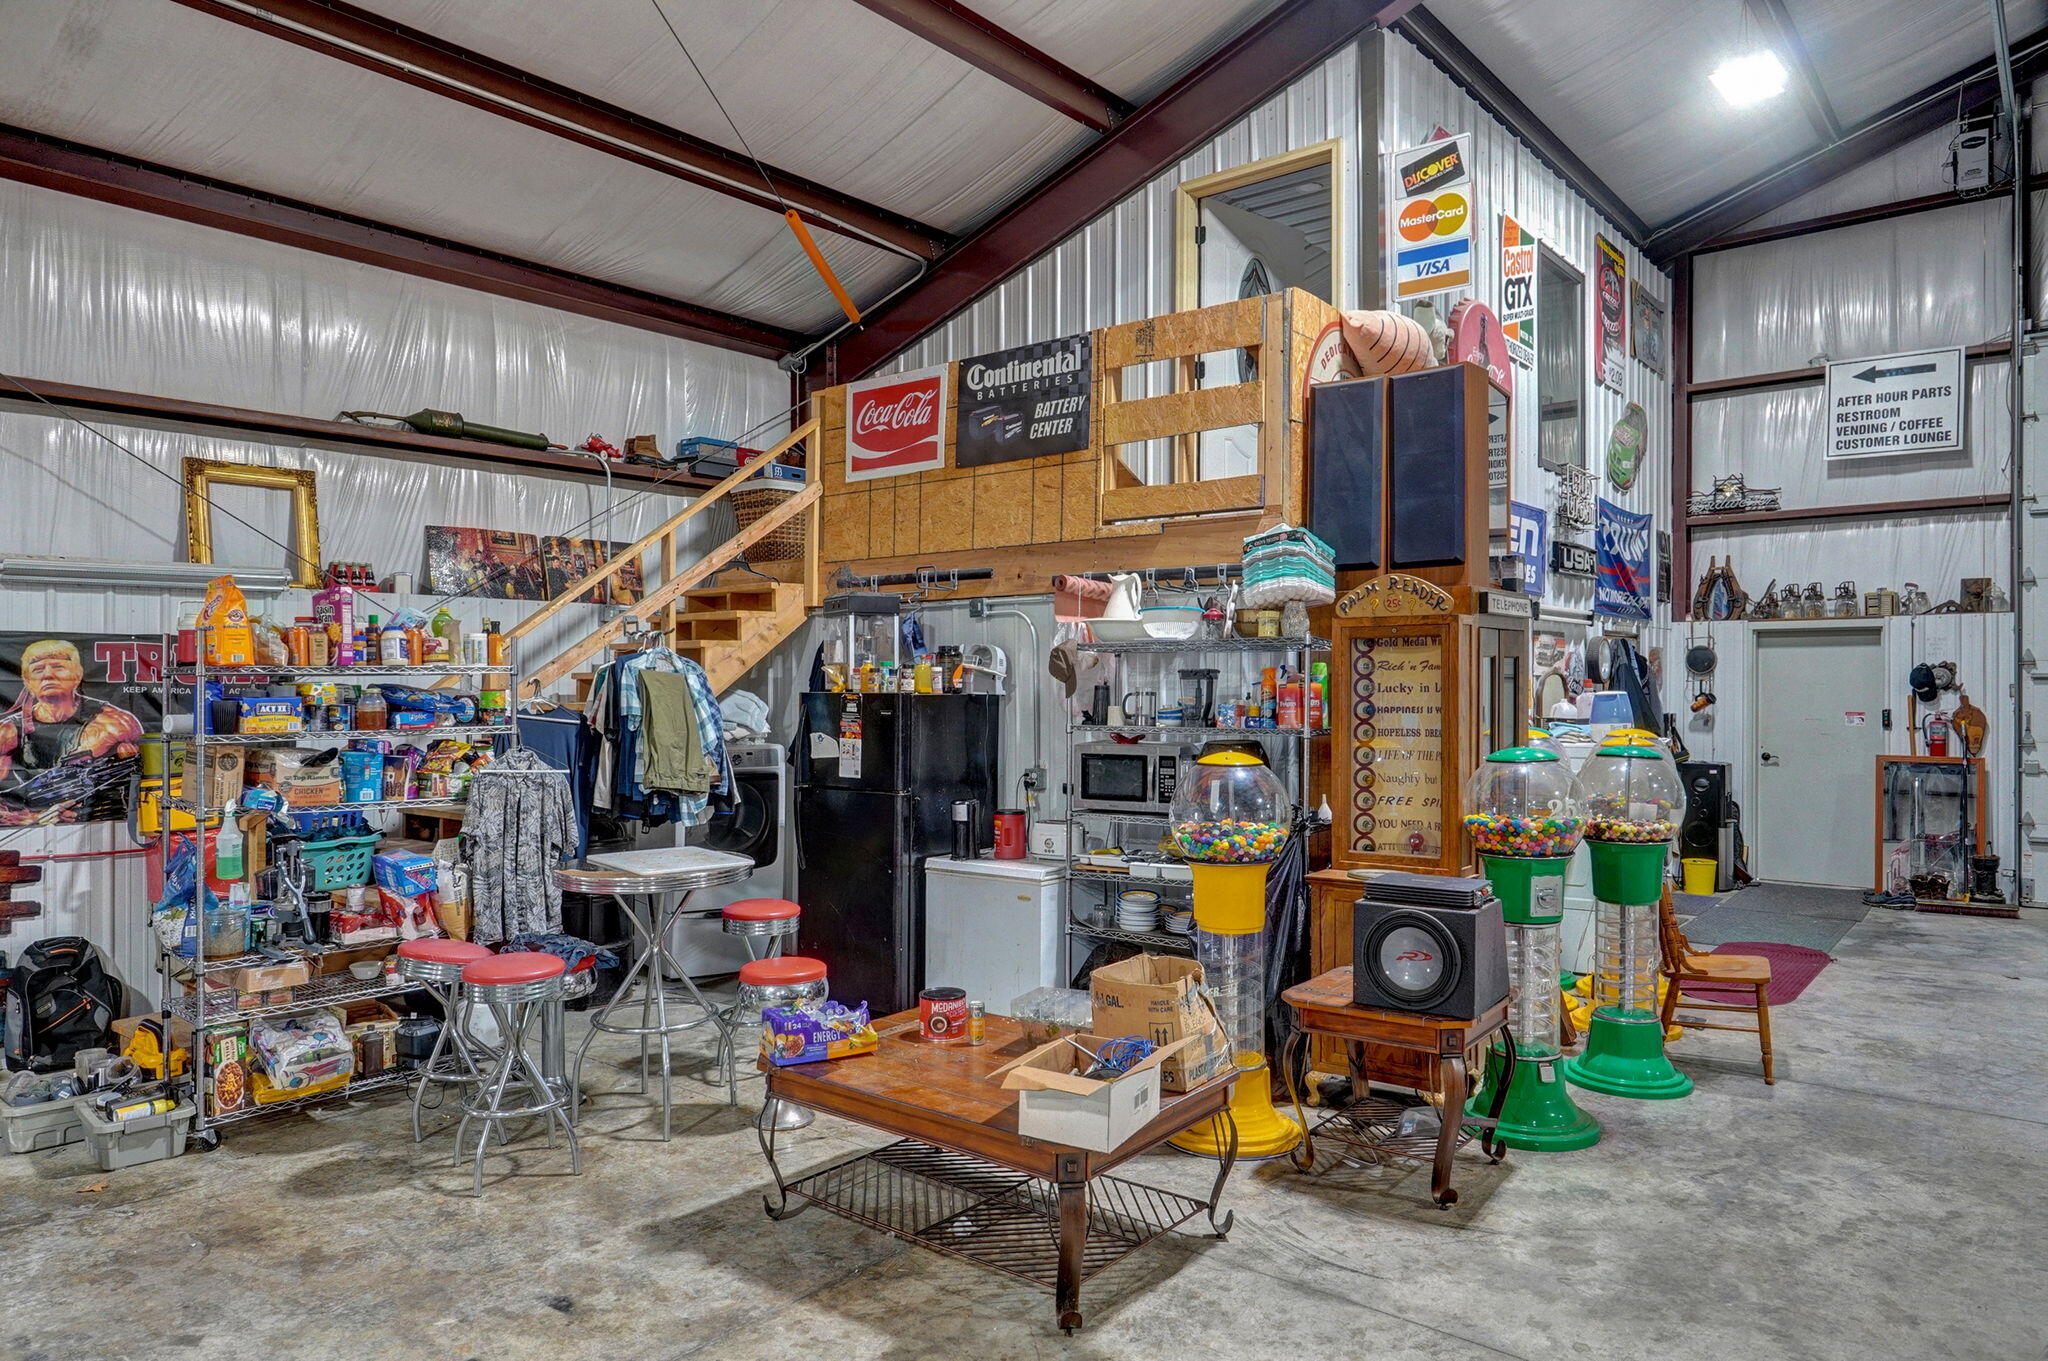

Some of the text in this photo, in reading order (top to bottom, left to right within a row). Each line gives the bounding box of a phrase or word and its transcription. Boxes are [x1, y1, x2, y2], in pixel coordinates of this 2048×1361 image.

[1403, 153, 1459, 188] DISCOVER
[1400, 204, 1465, 229] MasterCard
[1416, 258, 1450, 277] VISA
[1503, 248, 1534, 277] Castrol
[1504, 275, 1533, 311] GTX
[967, 343, 1082, 390] Continental
[976, 374, 1073, 401] BATTERIES
[1836, 386, 1951, 408] AFTER HOUR PARTS
[856, 388, 938, 435] Coca-Cola
[1034, 395, 1087, 419] BATTERY
[1836, 407, 1901, 423] RESTROOM
[1029, 418, 1074, 440] CENTER
[1836, 422, 1887, 437] VENDING
[1899, 417, 1943, 431] COFFEE
[1836, 430, 1952, 450] CUSTOMER LOUNGE
[1340, 575, 1449, 615] PALM READER
[1492, 598, 1529, 613] TELEPHONE
[1376, 637, 1398, 647] Gold
[1402, 637, 1428, 647] Medal
[1377, 660, 1404, 673] Rich
[123, 686, 147, 694] KEEP
[152, 686, 191, 695] AMRICA
[1377, 683, 1414, 695] Lucky
[1420, 683, 1429, 692] in
[1377, 706, 1424, 715] HAPPINESS
[1427, 706, 1433, 714] IS
[1377, 728, 1421, 738] HOPELESS
[1377, 772, 1437, 787] Naughty but
[294, 787, 324, 795] CHICKEN
[1377, 795, 1413, 806] FREE
[1377, 818, 1397, 828] YOU
[813, 1030, 841, 1044] ENERGY
